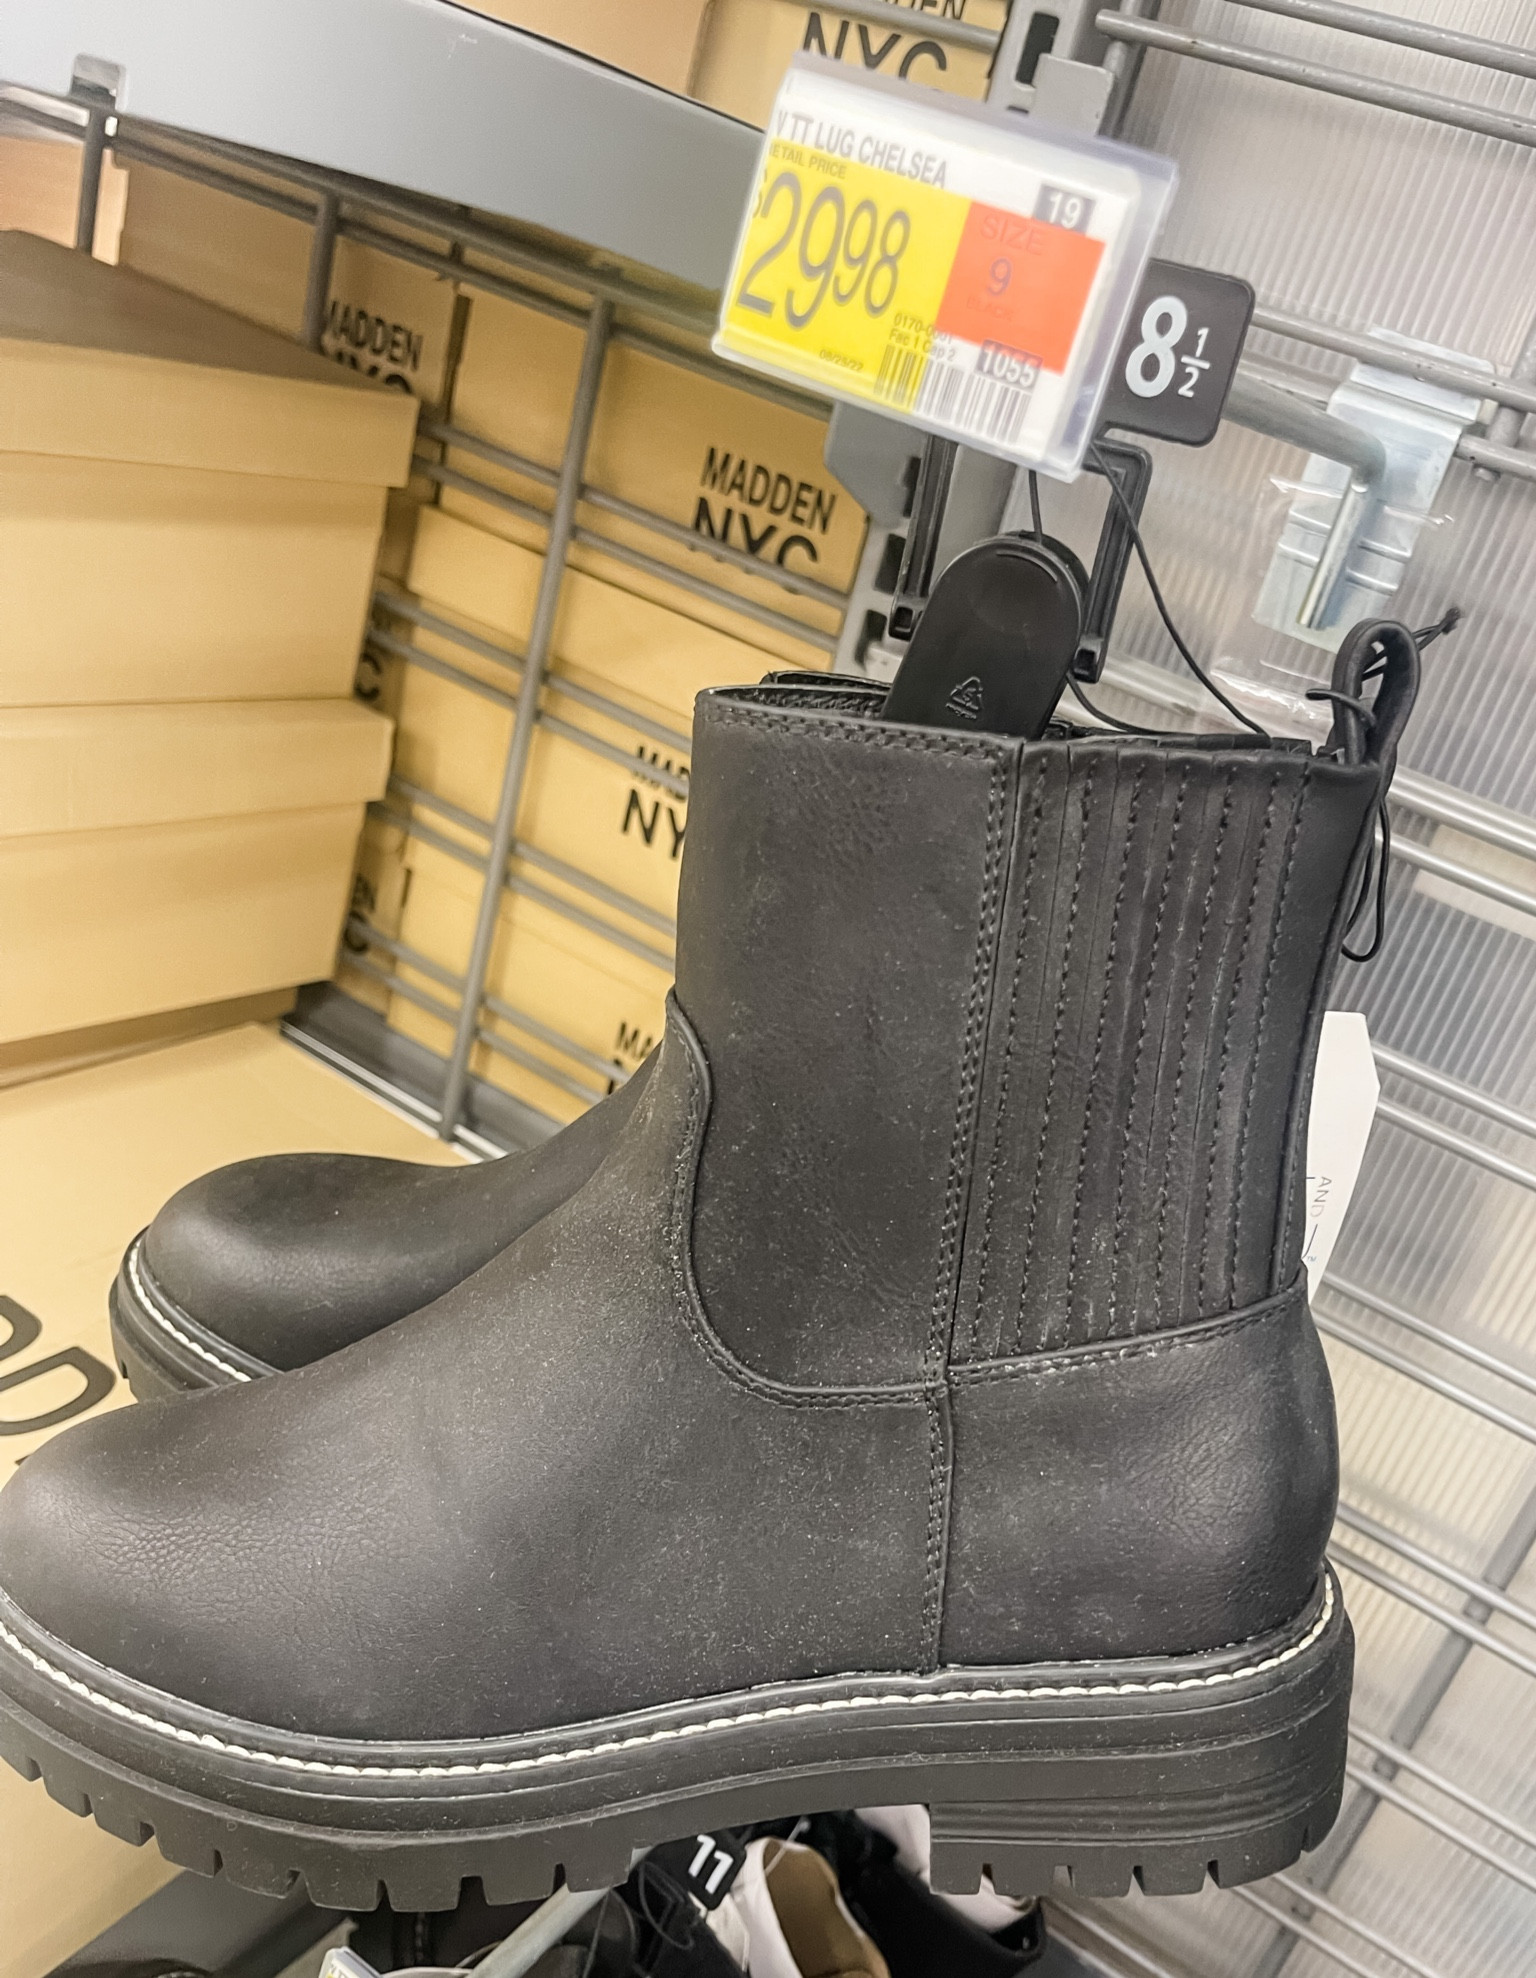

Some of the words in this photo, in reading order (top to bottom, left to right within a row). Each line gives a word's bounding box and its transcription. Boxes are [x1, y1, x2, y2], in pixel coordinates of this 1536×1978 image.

[808, 155, 848, 180] PRICE
[814, 121, 856, 158] LUG
[858, 135, 948, 191] CHELSEA
[1049, 191, 1082, 230] 19
[979, 213, 1044, 257] SIZE
[986, 257, 1013, 296] 9
[922, 339, 946, 361] Cap
[947, 348, 957, 363] 2
[981, 343, 1037, 388] 1055
[1125, 295, 1188, 399] 8
[700, 447, 836, 535] MADDEN
[1310, 1175, 1333, 1218] AND
[687, 1833, 735, 1895] 11
